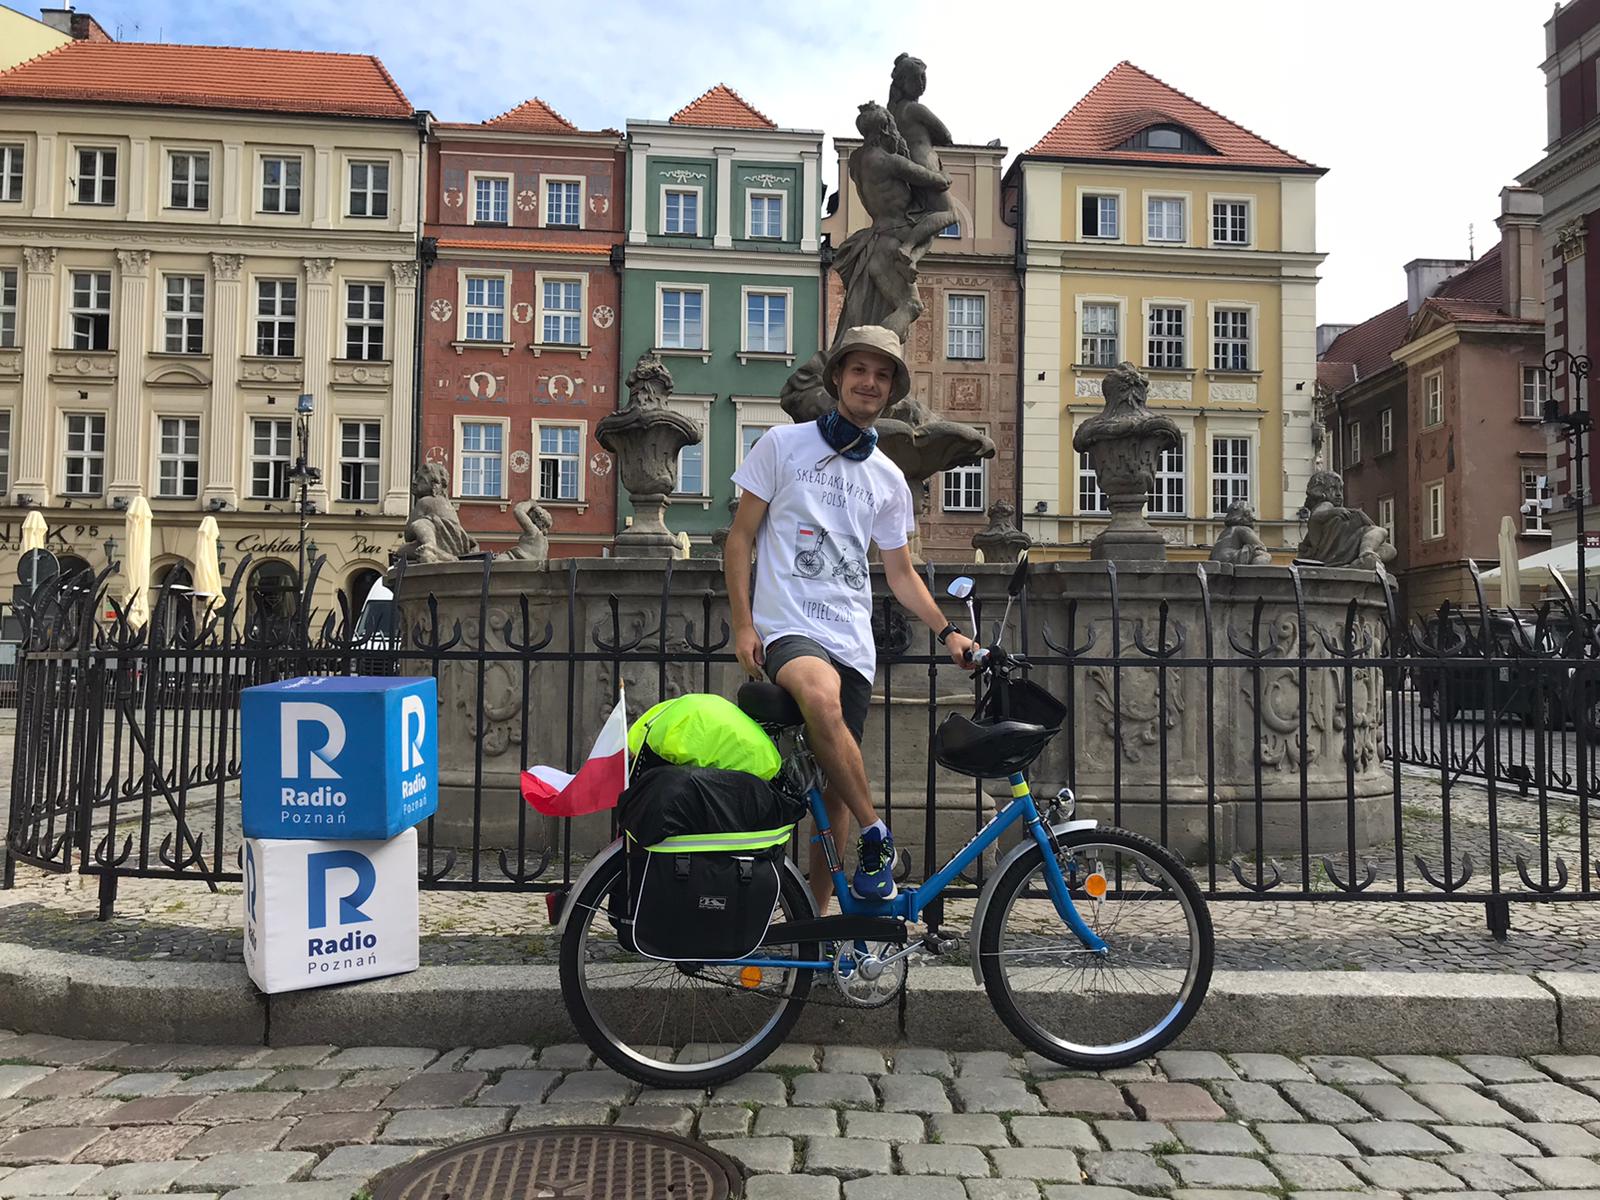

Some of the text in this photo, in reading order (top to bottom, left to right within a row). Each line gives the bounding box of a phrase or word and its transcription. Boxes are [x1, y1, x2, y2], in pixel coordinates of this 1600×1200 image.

[796, 468, 853, 495] SKŁADAKIM
[75, 525, 99, 537] 95
[0, 543, 74, 553] AUCJA
[235, 534, 381, 554] Cocktail Bar
[280, 701, 346, 779] R
[402, 694, 426, 772] R
[281, 786, 347, 807] Radio
[402, 772, 427, 799] Radio
[281, 810, 346, 824] Poznań
[307, 850, 376, 929] R
[308, 930, 377, 957] Radio
[308, 952, 377, 974] Poznań
